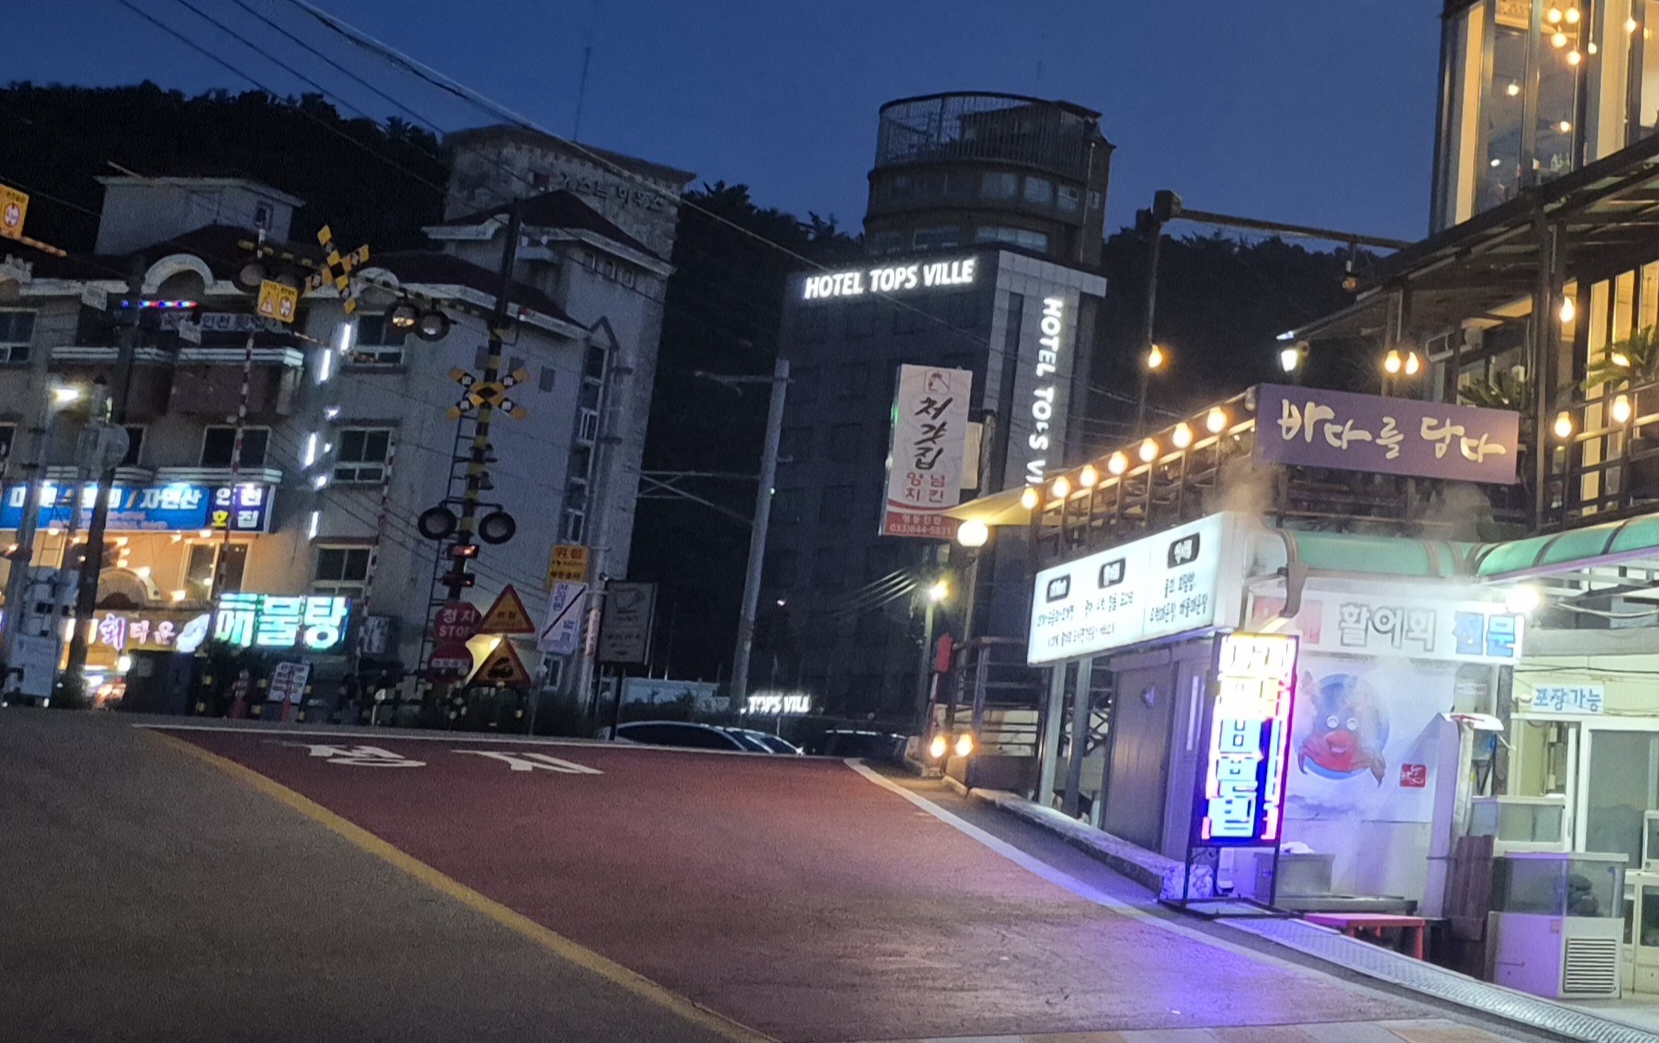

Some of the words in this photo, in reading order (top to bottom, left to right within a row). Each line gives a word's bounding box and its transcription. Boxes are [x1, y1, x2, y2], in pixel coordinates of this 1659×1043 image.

[804, 271, 863, 299] HOTEL
[870, 265, 917, 293] TOPS
[922, 258, 976, 287] VILLE
[1036, 298, 1063, 377] HOTEL
[1277, 400, 1405, 461] 바다를
[1420, 415, 1507, 463] 담다
[906, 472, 945, 488] 양념
[905, 488, 944, 503] 치킨
[441, 608, 475, 624] 정지
[1338, 602, 1437, 652] 활어회
[1451, 610, 1517, 657] 전문
[748, 693, 782, 715] TOPS
[1533, 686, 1603, 709] 포장가능
